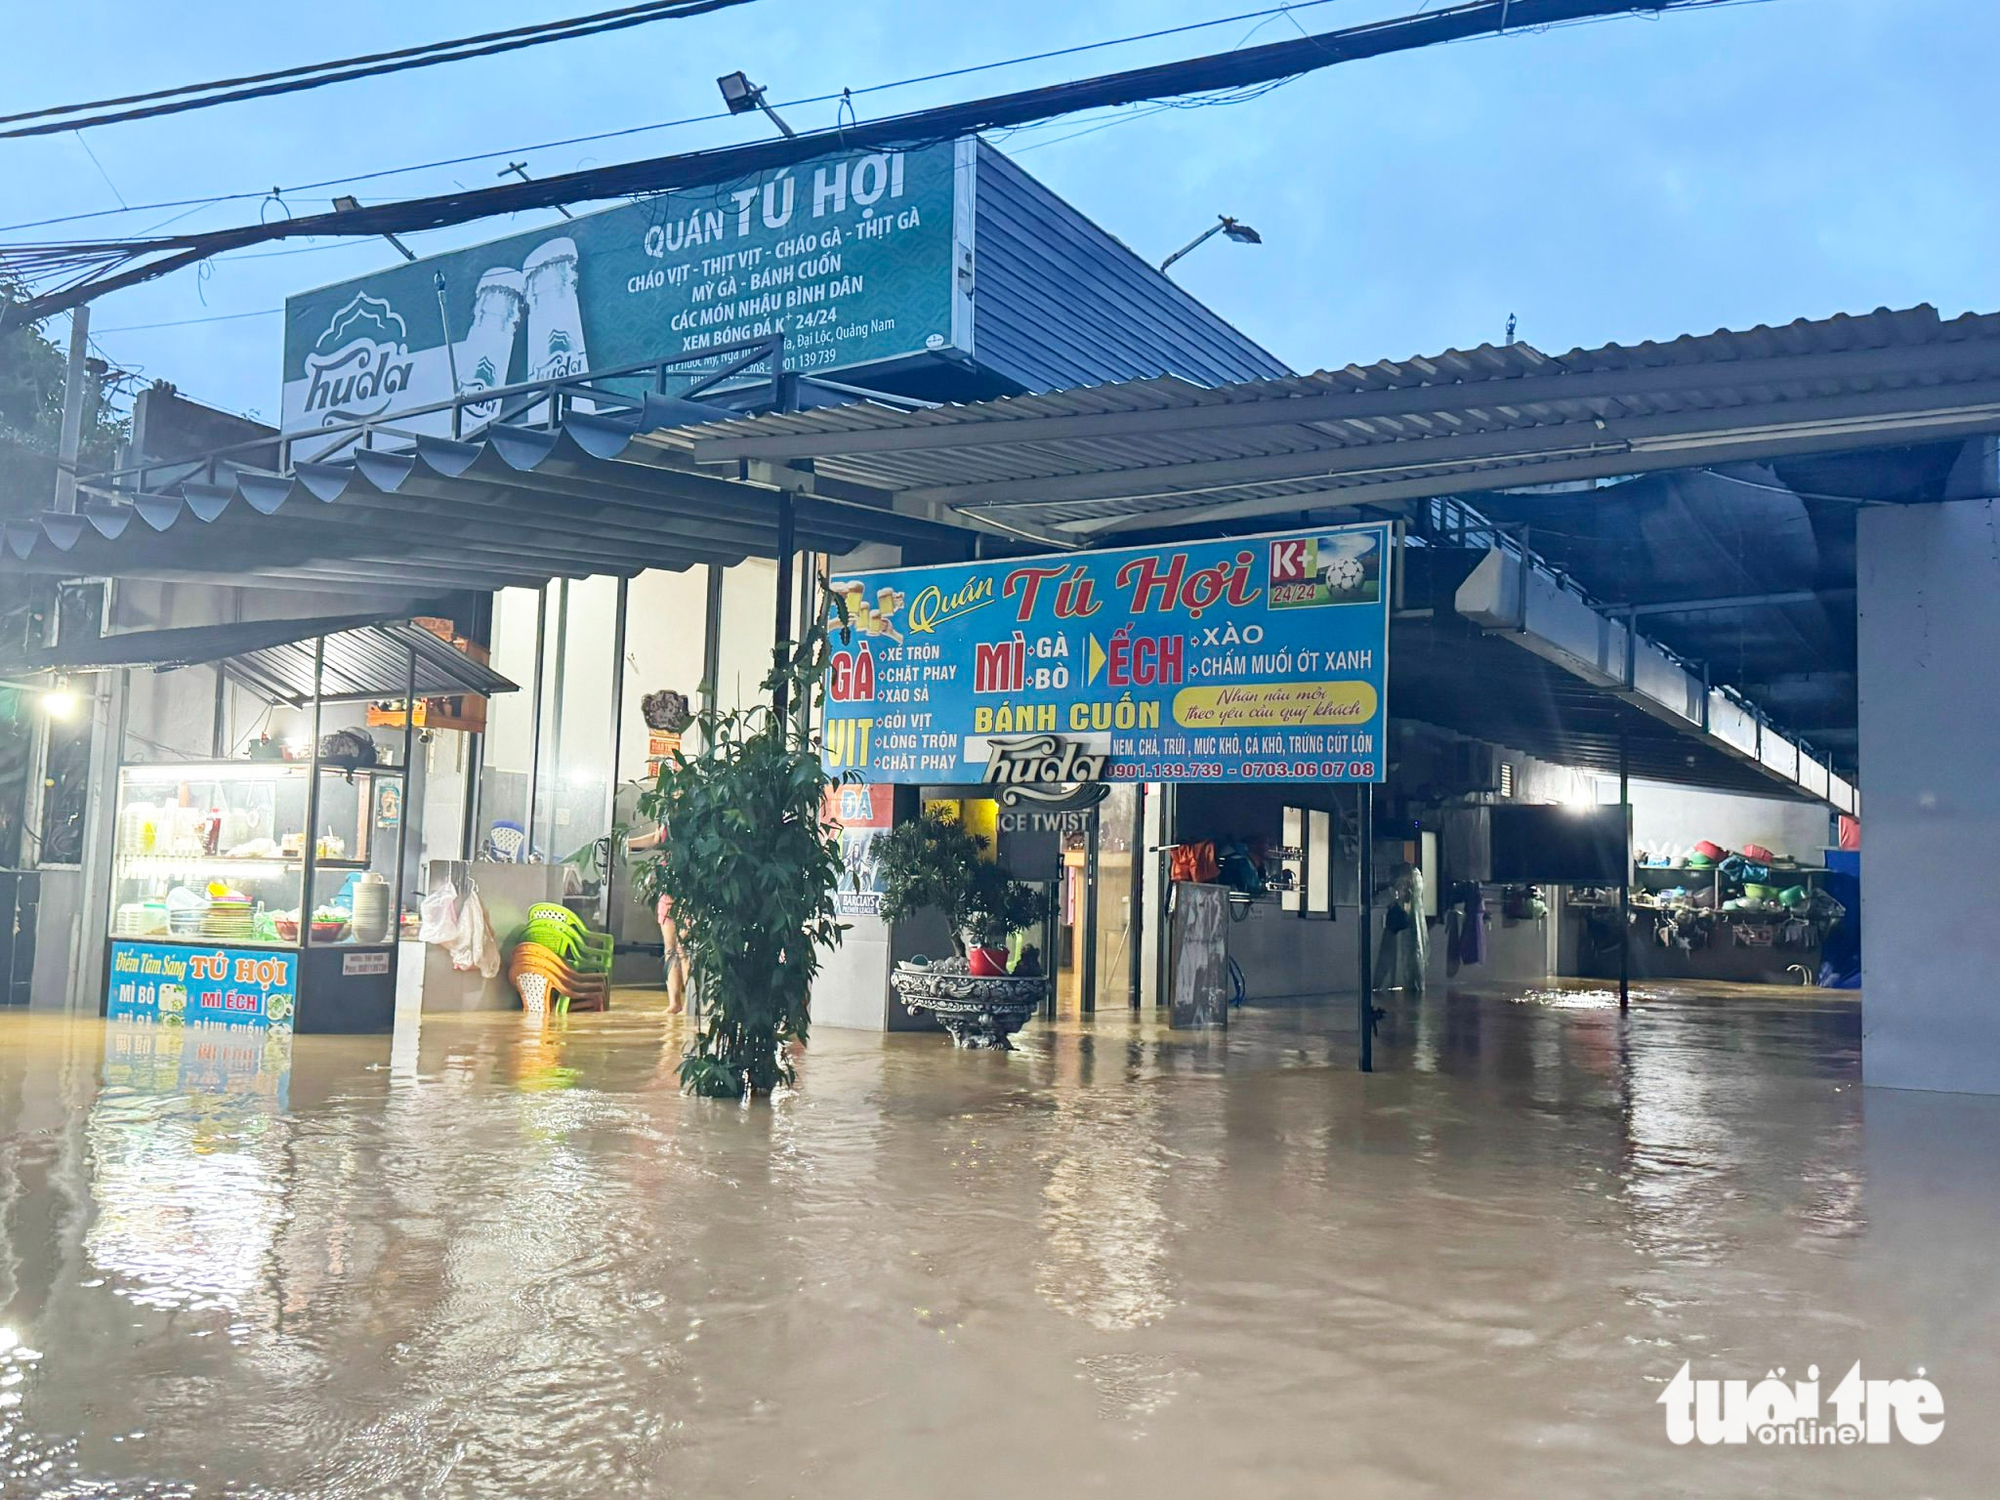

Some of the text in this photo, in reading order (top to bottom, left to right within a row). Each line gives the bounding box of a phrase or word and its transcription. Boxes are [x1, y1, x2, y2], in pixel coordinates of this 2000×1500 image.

[644, 152, 905, 258] QUÁN TÚ HỢI
[628, 272, 665, 294] CHÁO
[667, 264, 690, 287] VỊT
[702, 255, 735, 278] THỊT
[738, 248, 762, 271] VỊT
[775, 233, 816, 259] CHÁO
[820, 226, 842, 249] GÀ
[856, 215, 894, 240] THỊT
[897, 206, 920, 230] GÀ
[691, 280, 713, 303] MỲ
[717, 275, 737, 298] GÀ
[750, 264, 795, 291] BÁNH
[798, 251, 841, 279] CUỐN
[671, 275, 863, 331] CÁC MÓN NHẬU BÌNH DÂN
[682, 335, 710, 352] XEM
[714, 323, 750, 347] BÓNG
[753, 319, 772, 336] ĐÁ
[796, 307, 837, 330] 24/24
[797, 333, 813, 349] Đại
[815, 330, 834, 346] Lộc,
[836, 323, 868, 340] Quảng
[871, 318, 895, 334] Nam
[799, 352, 816, 367] 139
[818, 348, 836, 364] 739
[304, 346, 414, 413] huda
[908, 551, 1262, 635] Quán Tú Hợi
[1274, 585, 1316, 603] 24/24
[1036, 631, 1069, 658] GÀ
[1202, 621, 1264, 647] XÀO
[907, 643, 940, 663] TRỘN
[974, 630, 1026, 694] MÌ
[1107, 621, 1184, 687] ẾCH
[1201, 645, 1372, 677] CHẤM MUỐI ỚT XANH
[829, 641, 875, 703] GÀ
[886, 665, 957, 684] CHẶT PHAY
[1035, 662, 1069, 690] BÒ
[886, 684, 929, 703] XÀO SẢ
[1264, 687, 1290, 701] nấu
[884, 710, 933, 731] GỎI VỊT
[974, 691, 1160, 734] BÁNH CUỐN
[1219, 707, 1244, 726] yêu
[1249, 705, 1275, 718] cầu
[1280, 706, 1311, 724] quý
[1313, 701, 1361, 716] khách
[883, 731, 957, 751] LÒNG TRỘN
[1113, 739, 1136, 758] NEM,
[1139, 734, 1160, 757] CHẢ,
[1194, 736, 1216, 758] MỰC
[1219, 732, 1242, 757] KHÔ,
[1245, 731, 1259, 754] CÁ
[1262, 732, 1286, 756] KHÔ,
[1289, 731, 1323, 754] TRỨNG
[1327, 731, 1348, 753] CÚT
[1351, 730, 1373, 757] LỘN
[882, 753, 957, 773] CHẶT PHAY
[981, 735, 1106, 783] huda
[1105, 762, 1223, 778] 0901.139.739
[1242, 762, 1317, 778] 0703.06
[1321, 762, 1345, 778] 07
[1349, 762, 1374, 778] 08
[842, 784, 873, 820] ĐÁ
[997, 813, 1088, 831] ICE TWIST
[843, 895, 875, 906] BARCLAYS
[162, 954, 187, 981] Sáng
[190, 951, 230, 980] TÚ
[234, 956, 288, 991] HỢI
[120, 981, 155, 1005] MÌ BÒ
[202, 988, 257, 1011] MÌ ẾCH
